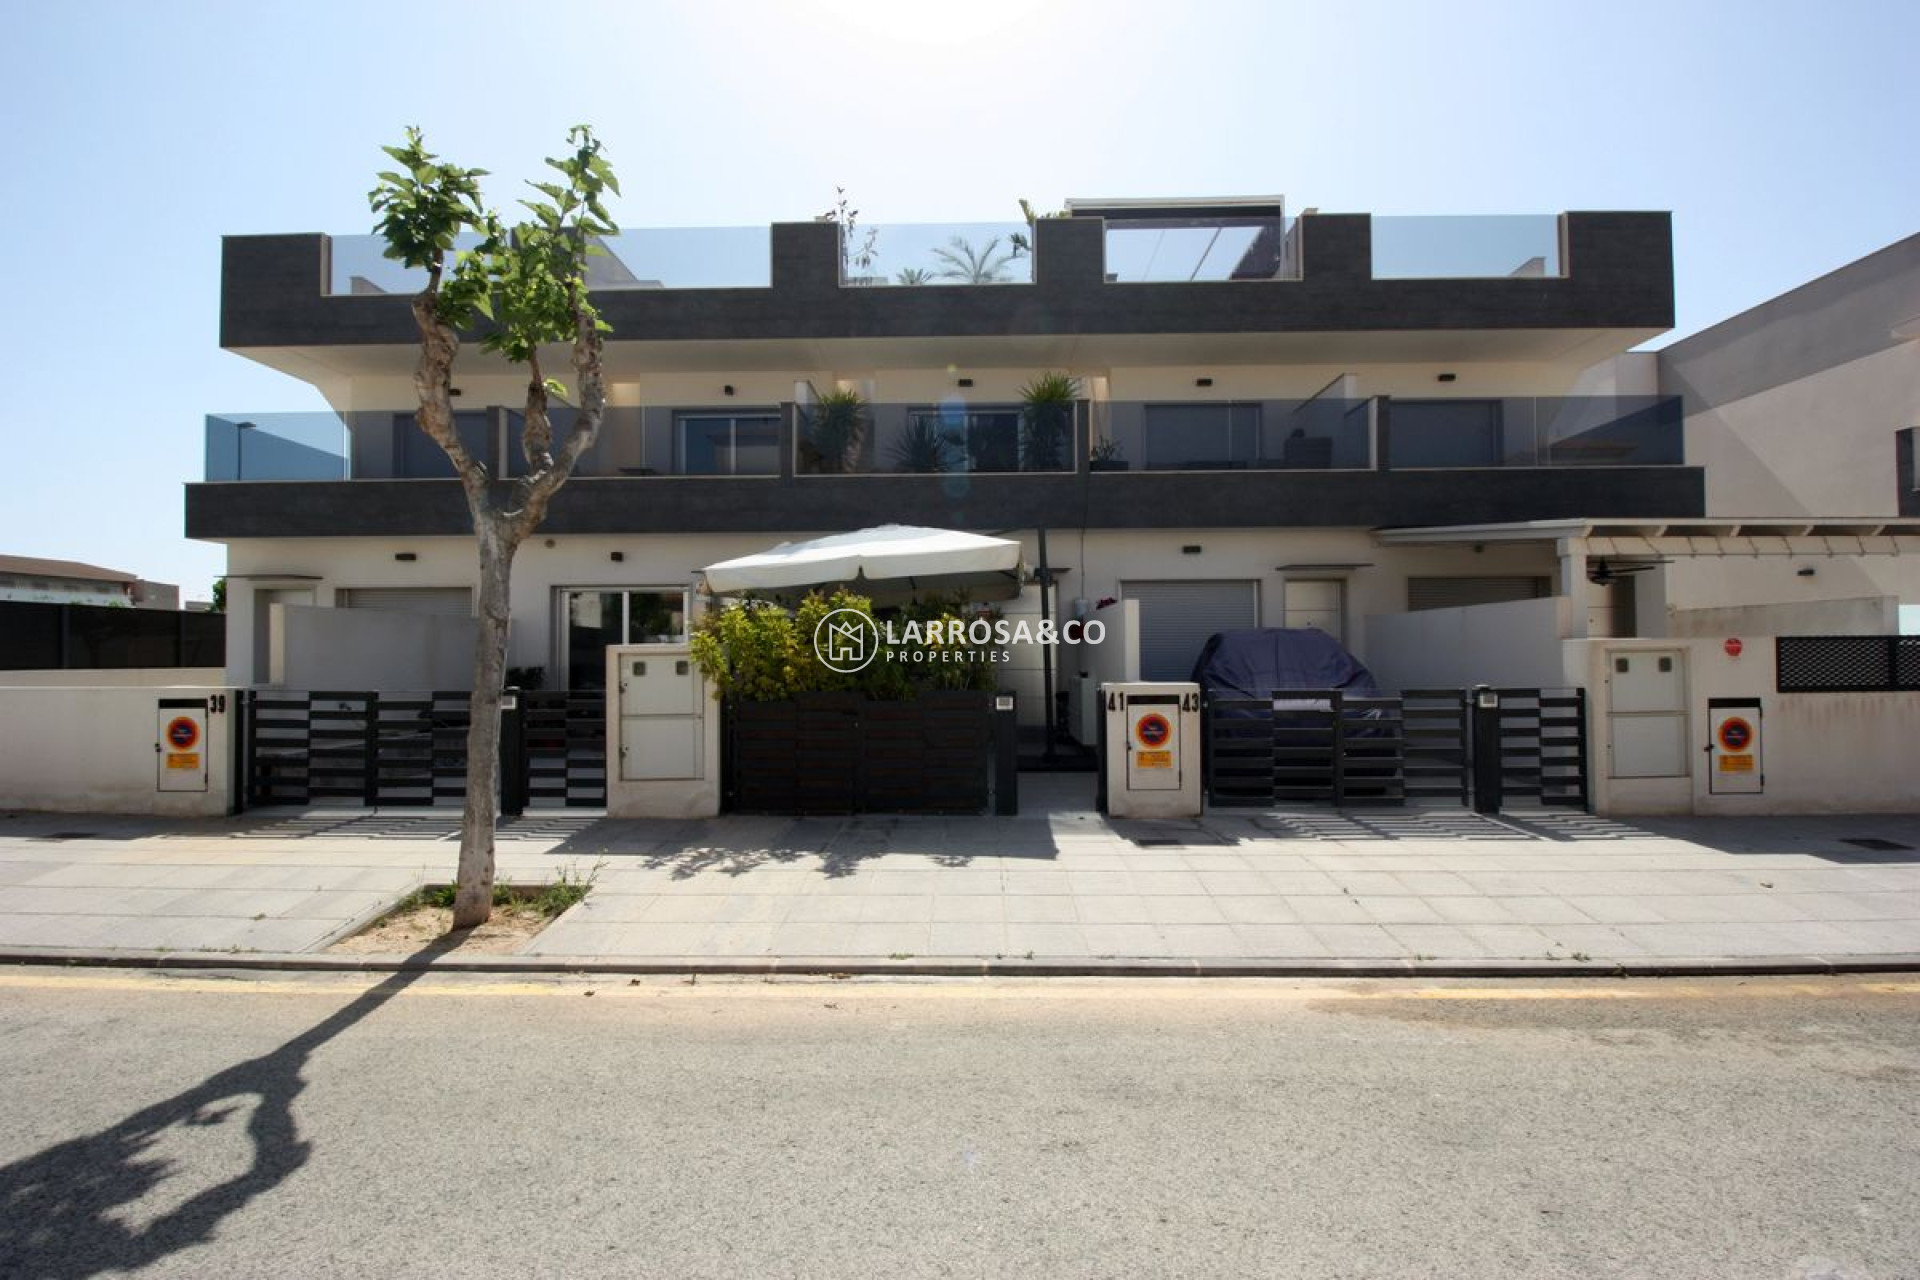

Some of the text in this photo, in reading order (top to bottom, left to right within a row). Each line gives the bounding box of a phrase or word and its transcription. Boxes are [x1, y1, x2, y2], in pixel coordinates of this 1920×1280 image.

[210, 694, 225, 713] 39
[1108, 691, 1124, 712] 41
[1182, 692, 1199, 712] 43
